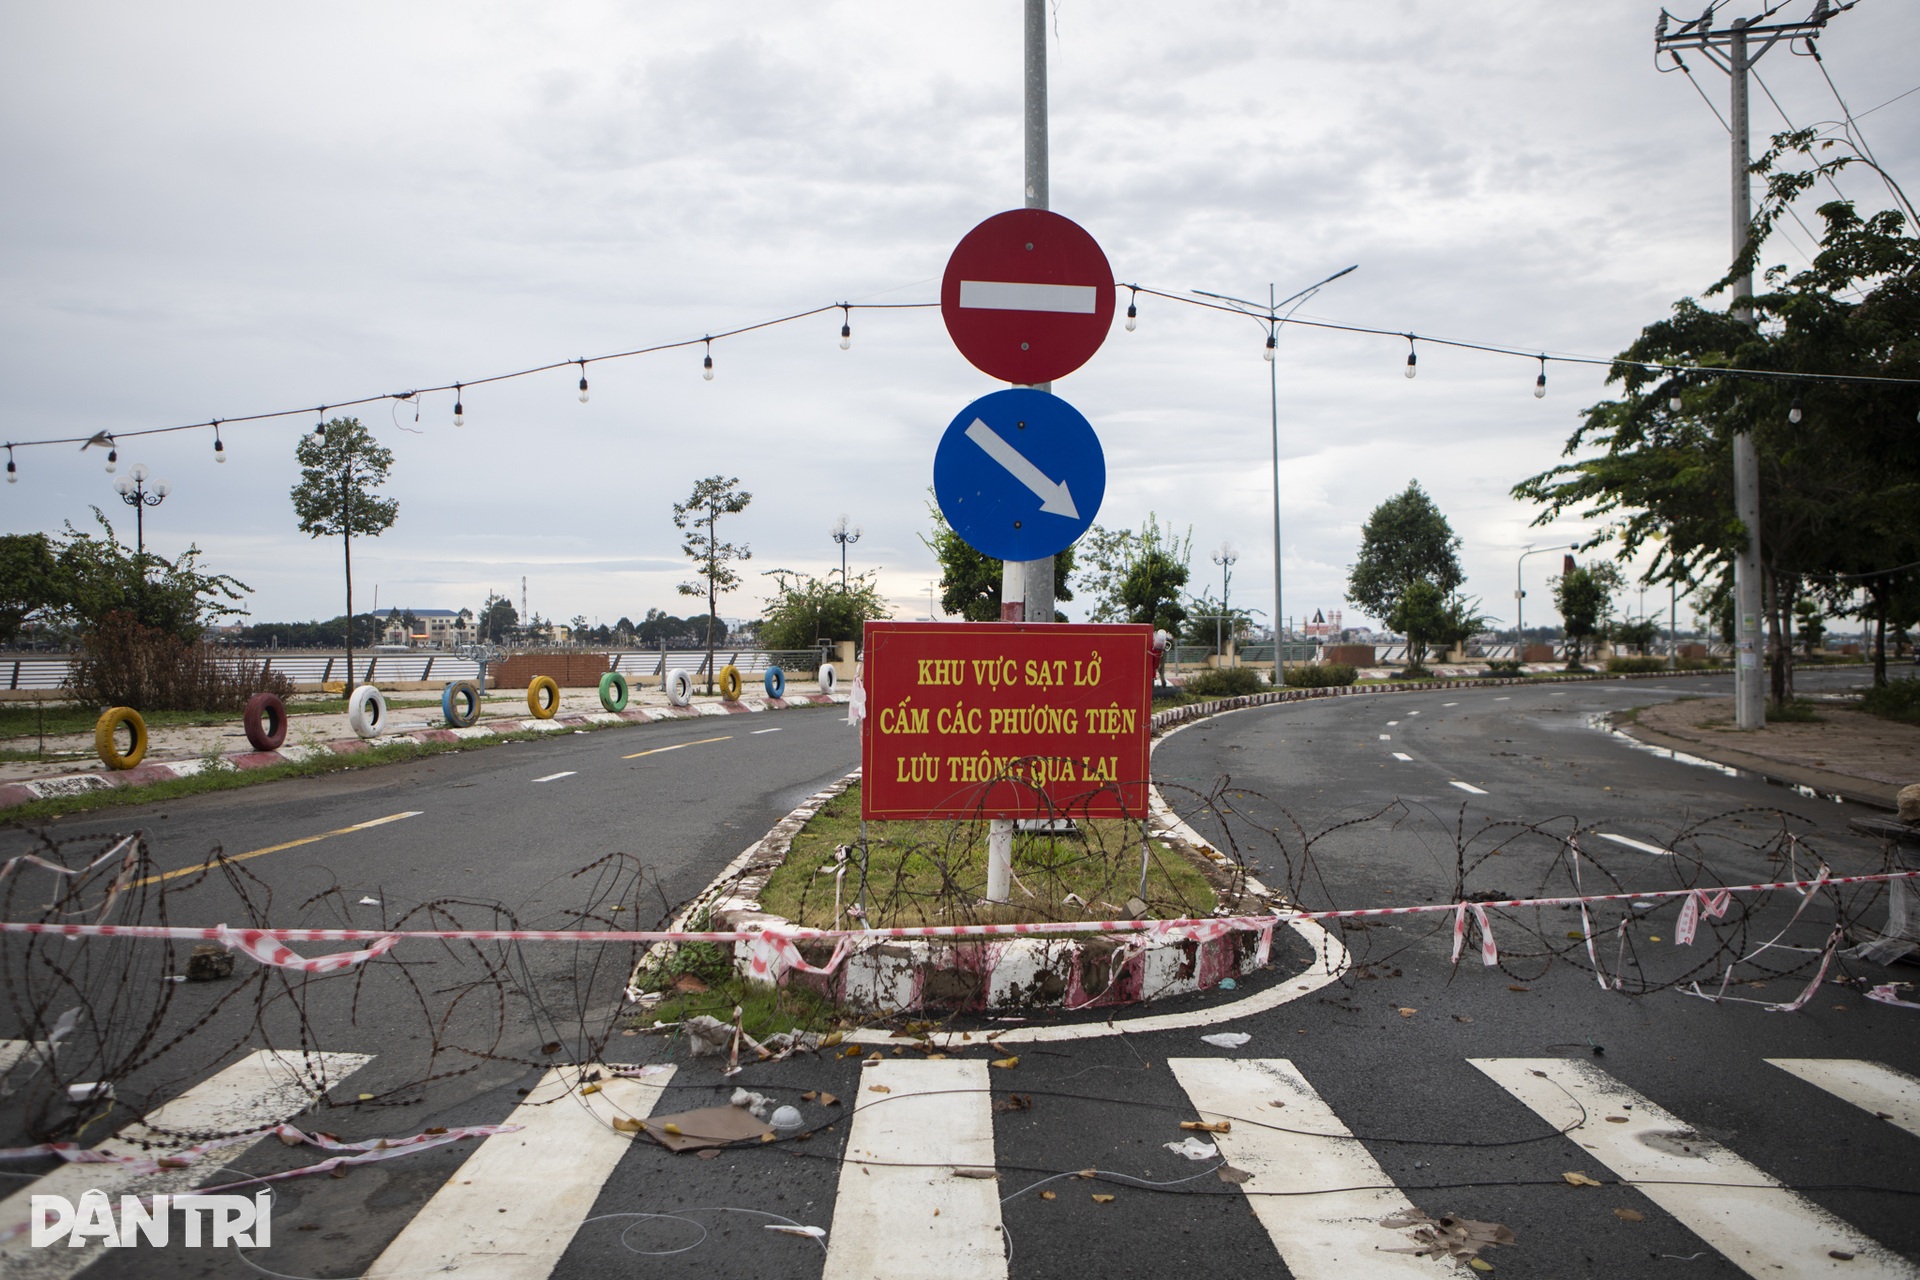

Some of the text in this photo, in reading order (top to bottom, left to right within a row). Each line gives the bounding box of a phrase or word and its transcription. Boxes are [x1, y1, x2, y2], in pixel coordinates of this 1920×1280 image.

[917, 650, 1102, 692] KHU VỰC SẠT LỞ
[879, 695, 1137, 740] CẤM CÁC PHƯƠNG TIỆN
[896, 749, 1118, 789] LƯU THÔNG QUA LẠI
